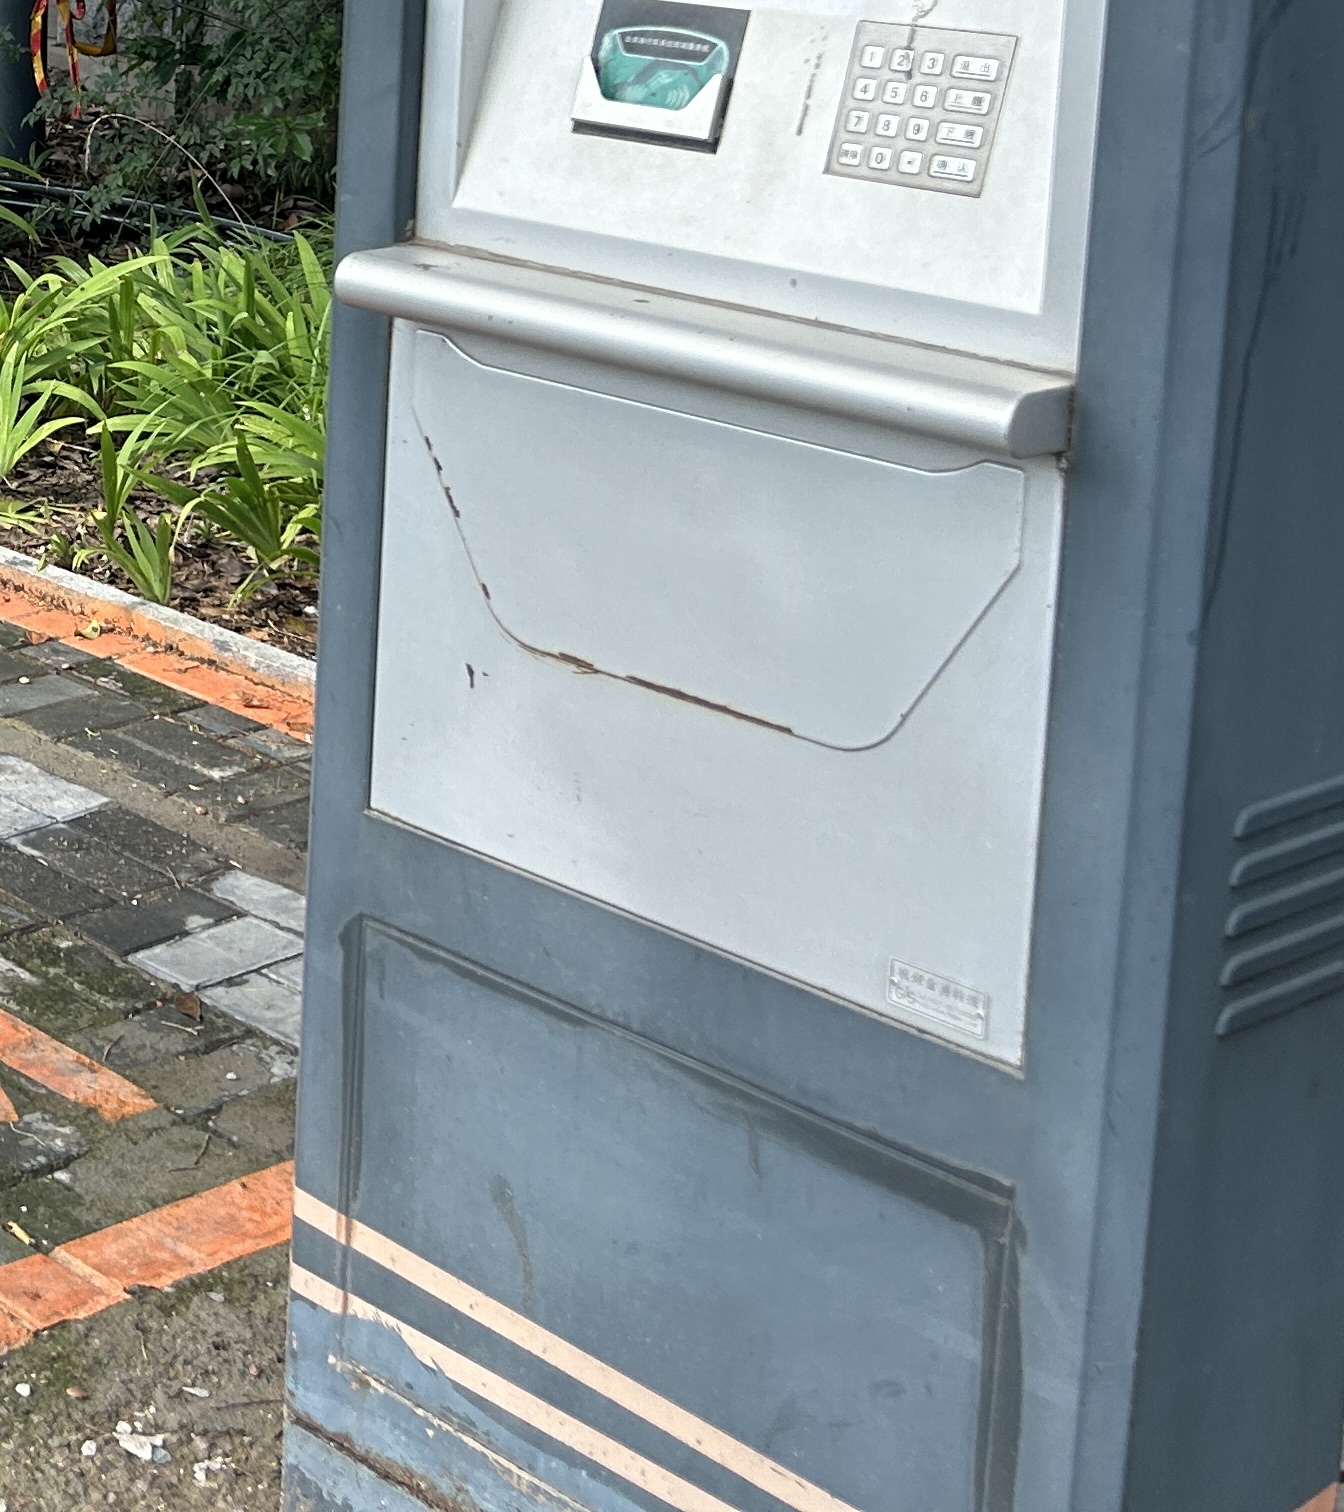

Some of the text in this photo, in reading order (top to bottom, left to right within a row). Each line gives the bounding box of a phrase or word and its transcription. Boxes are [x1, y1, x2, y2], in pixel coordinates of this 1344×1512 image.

[926, 57, 935, 70] 3
[860, 83, 928, 102] 4 5 6
[854, 115, 921, 136] 7 8 9
[875, 151, 884, 165] 0
